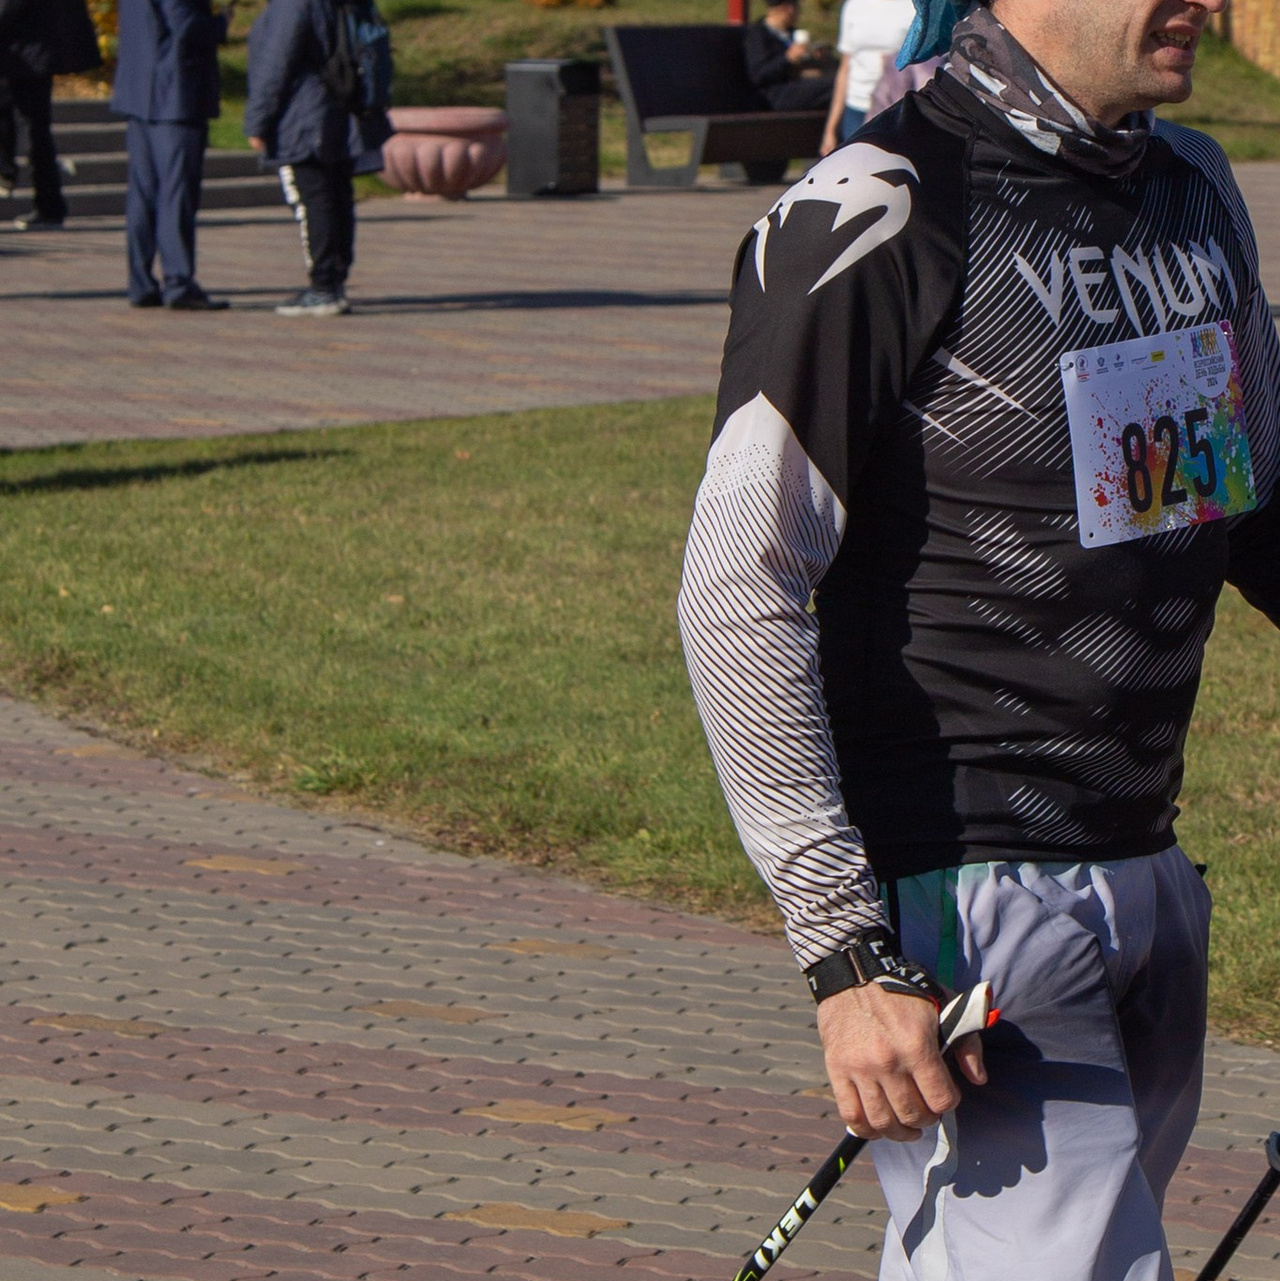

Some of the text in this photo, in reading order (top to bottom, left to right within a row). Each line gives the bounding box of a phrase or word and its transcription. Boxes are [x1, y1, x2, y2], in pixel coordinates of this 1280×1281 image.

[1013, 235, 1239, 338] VENUM
[1121, 407, 1217, 513] 825
[754, 1187, 819, 1271] LEKI
